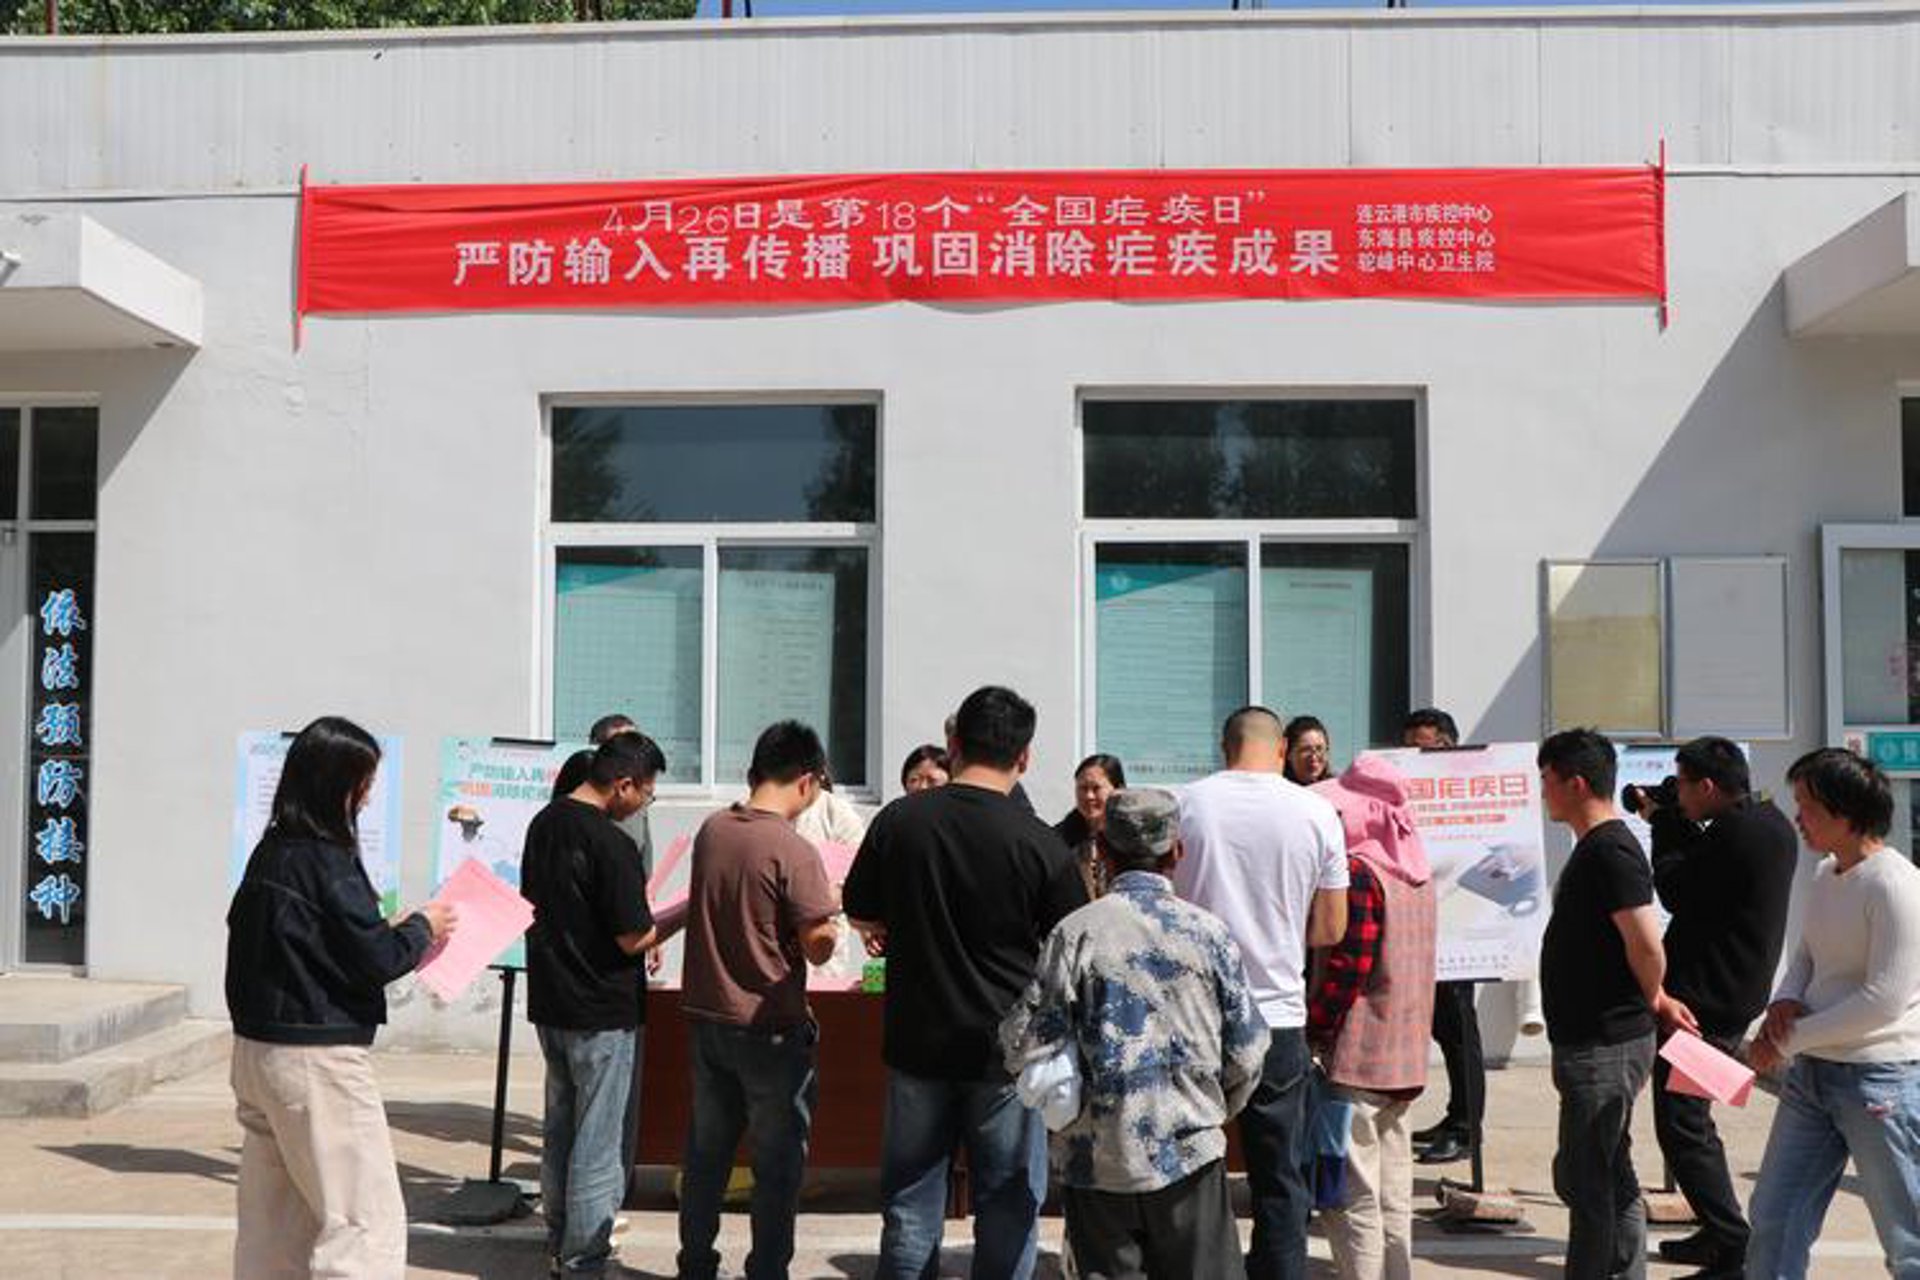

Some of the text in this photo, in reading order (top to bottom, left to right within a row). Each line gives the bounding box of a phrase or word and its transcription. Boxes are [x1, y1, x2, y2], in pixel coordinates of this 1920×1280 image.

[453, 229, 1340, 286] 严防输入再传播 巩固消除疟疾成果
[30, 588, 87, 924] 依法预防接种
